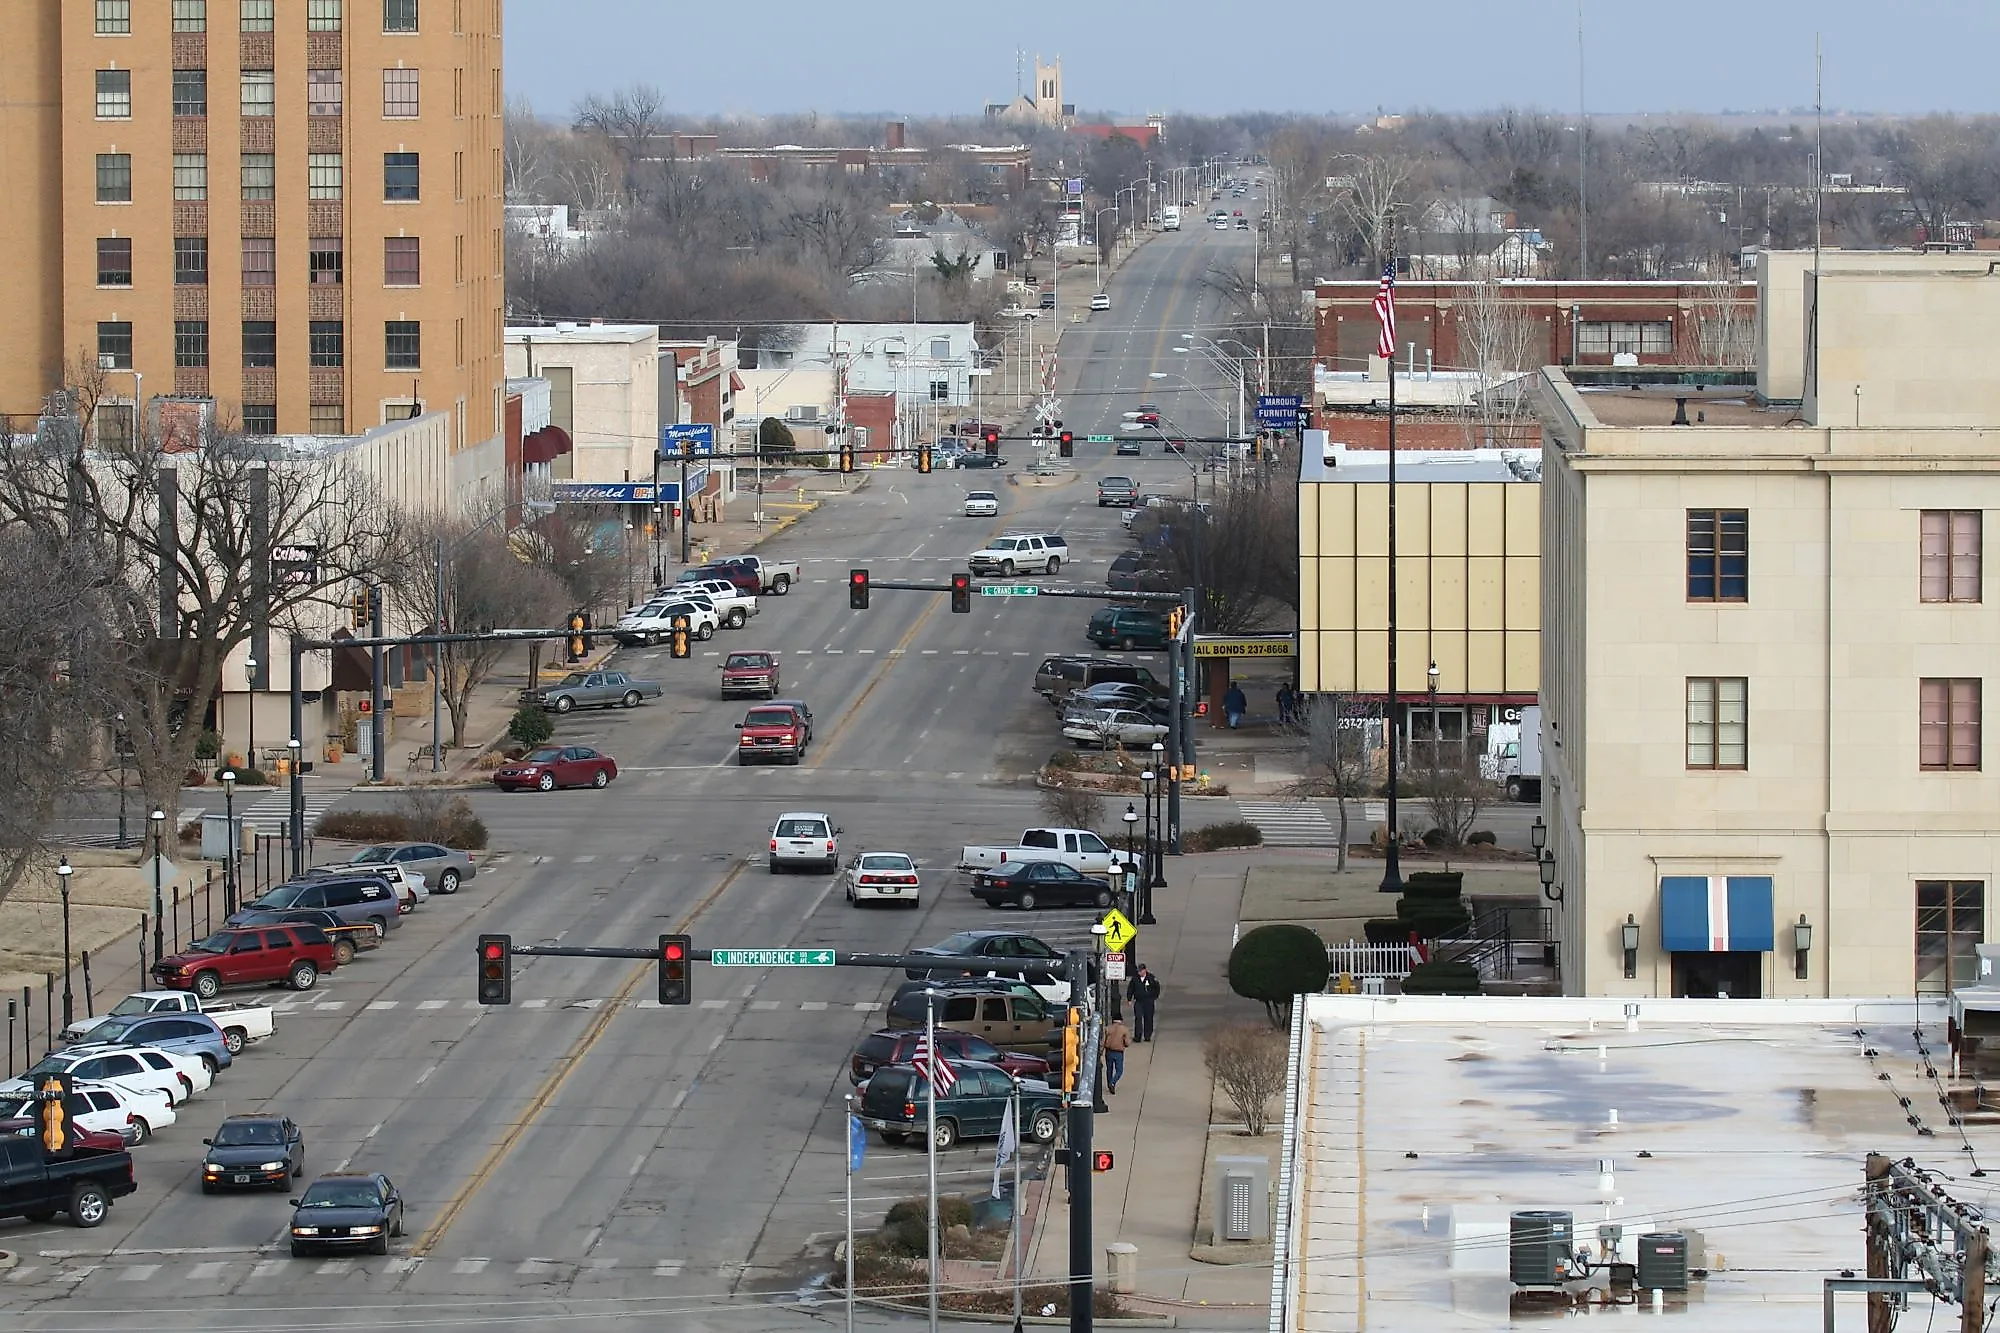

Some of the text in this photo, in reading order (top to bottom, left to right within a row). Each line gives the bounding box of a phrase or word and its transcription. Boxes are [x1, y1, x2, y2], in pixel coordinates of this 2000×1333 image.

[1265, 398, 1296, 406] MARQUIS
[1258, 409, 1297, 418] FURNITUR
[1265, 419, 1282, 428] Since
[553, 488, 626, 501] errifield
[994, 586, 1011, 595] GRAND
[1213, 645, 1246, 655] BONDS
[1247, 644, 1289, 655] 237-8668
[1472, 714, 1487, 728] SALE
[716, 951, 726, 965] S.
[727, 951, 796, 964] INDEPENDENCE
